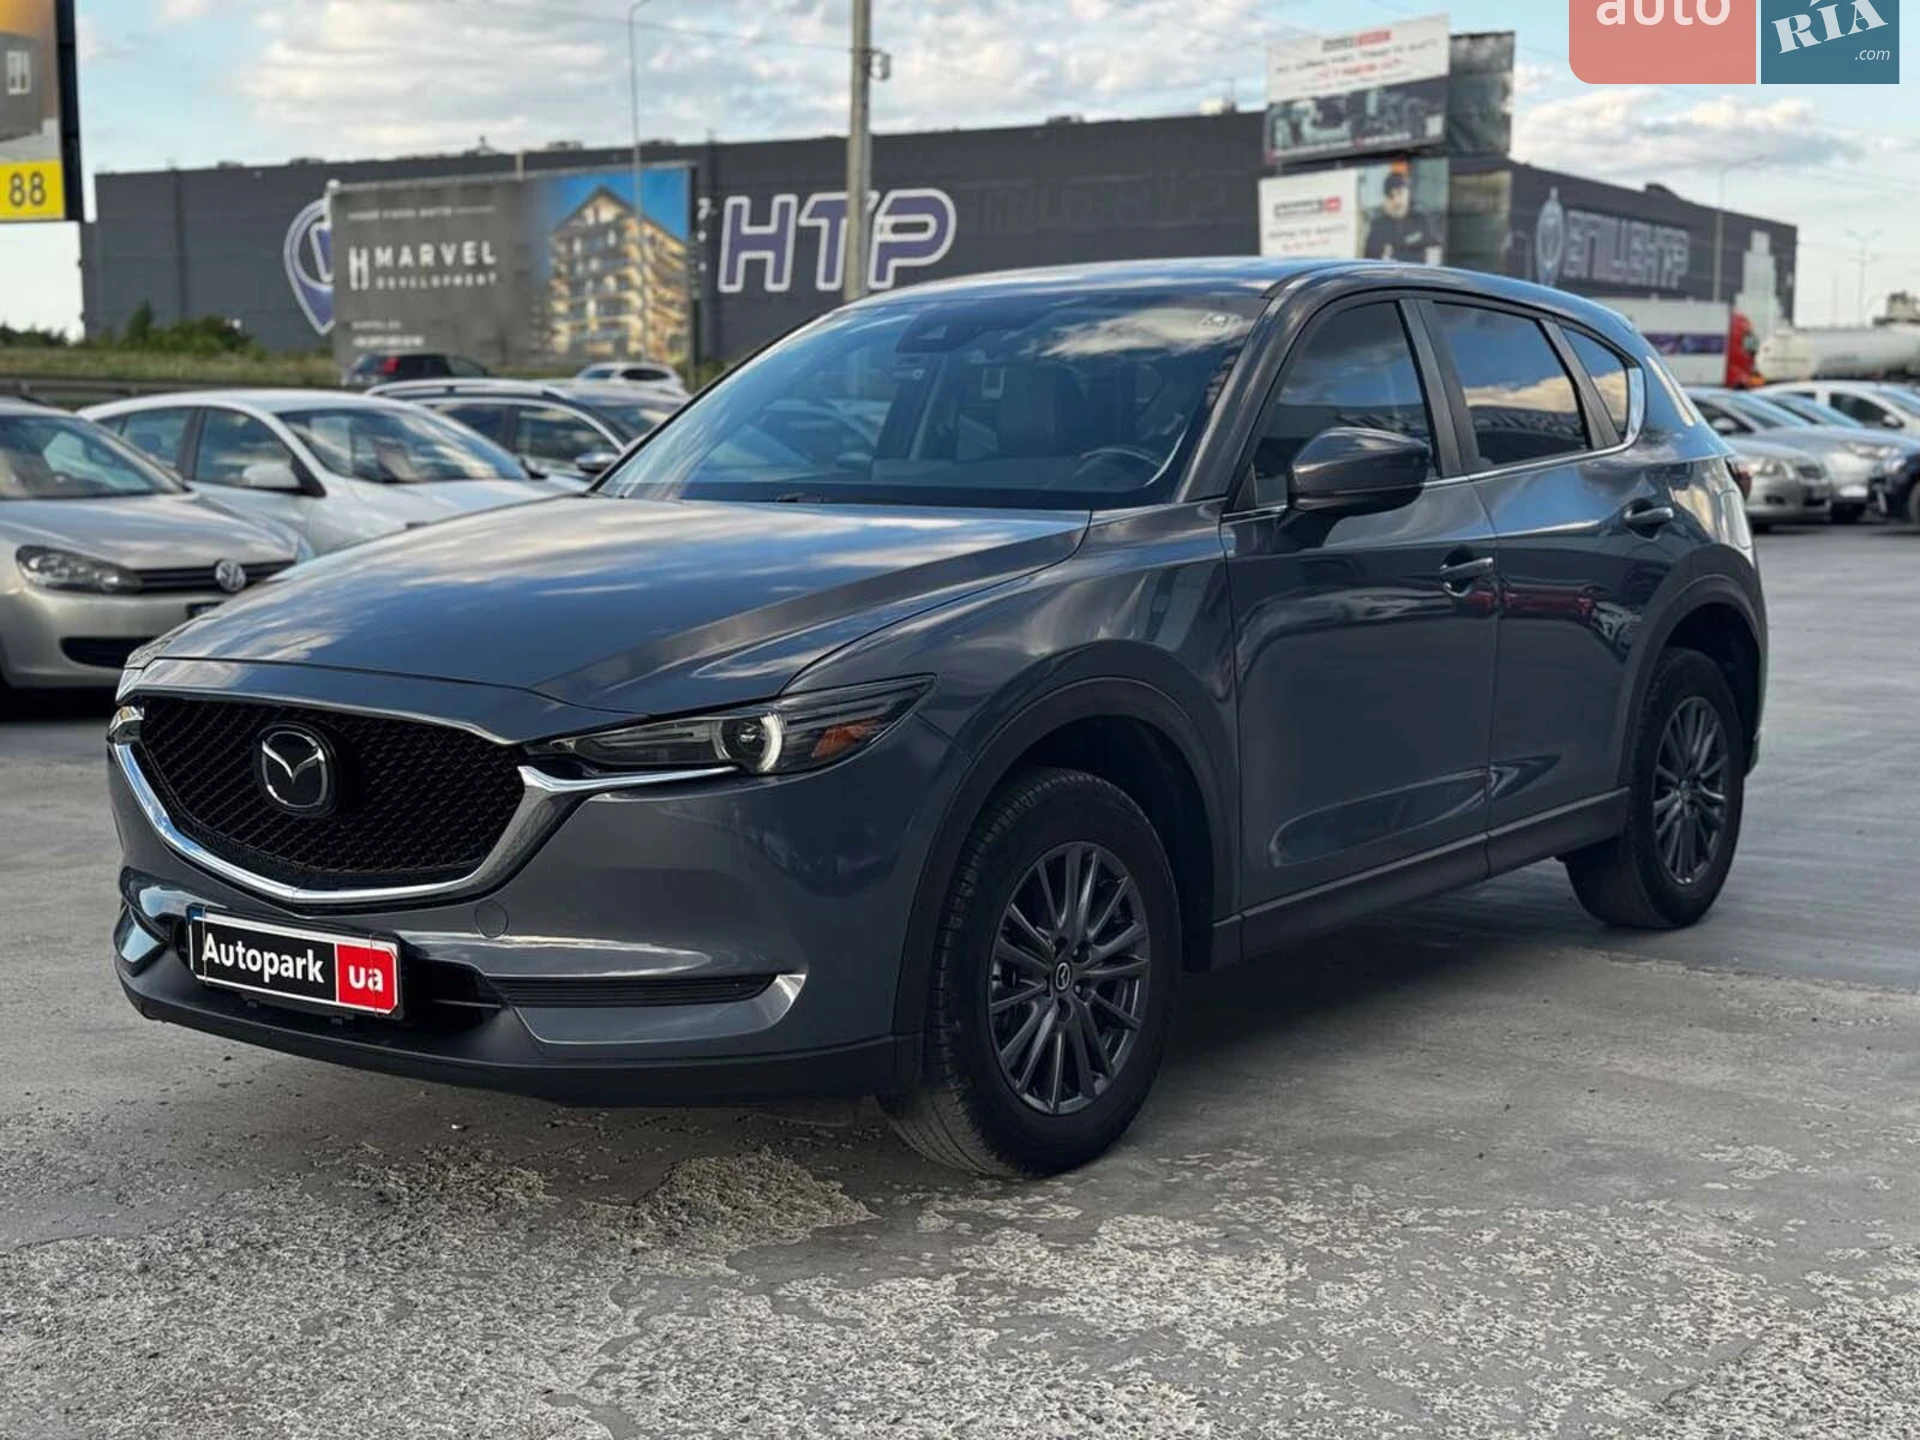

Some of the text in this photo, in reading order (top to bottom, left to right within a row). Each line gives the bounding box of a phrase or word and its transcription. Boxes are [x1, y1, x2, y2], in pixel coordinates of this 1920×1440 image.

[9, 171, 47, 209] 88
[374, 241, 497, 268] MARVEL
[202, 932, 384, 992] Autopark ua
